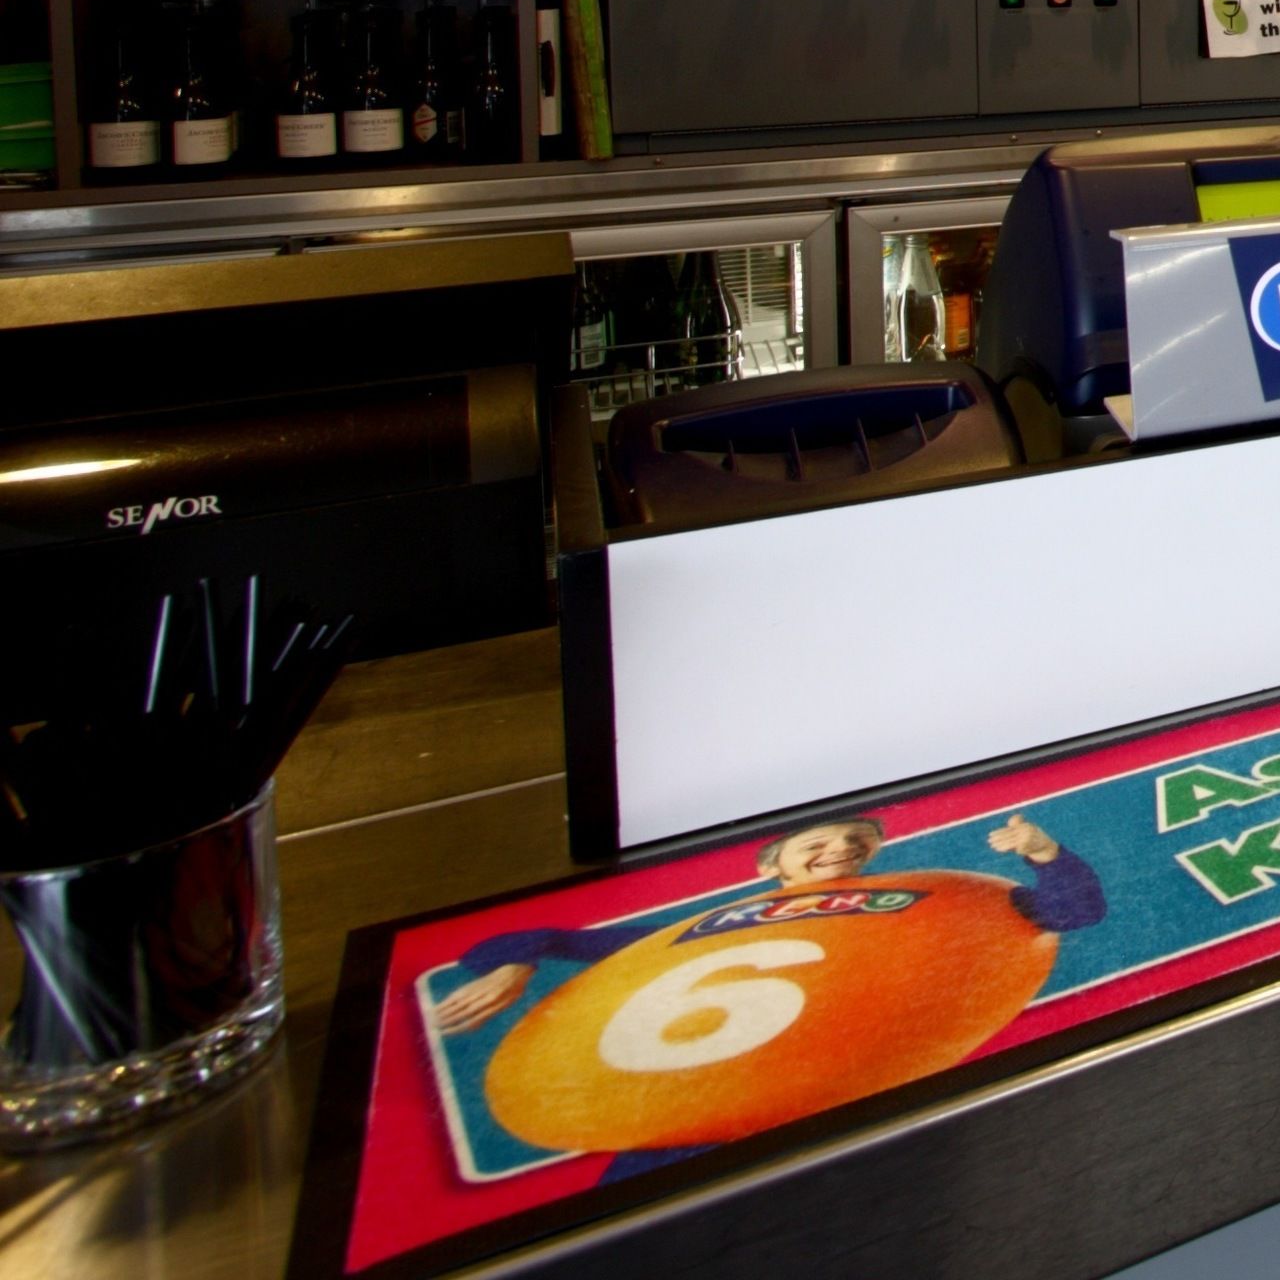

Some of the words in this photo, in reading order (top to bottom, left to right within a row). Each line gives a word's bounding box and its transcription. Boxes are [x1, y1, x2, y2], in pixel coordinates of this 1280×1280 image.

[107, 494, 222, 535] SENOR
[706, 890, 912, 929] KENO
[599, 938, 826, 1072] 6
